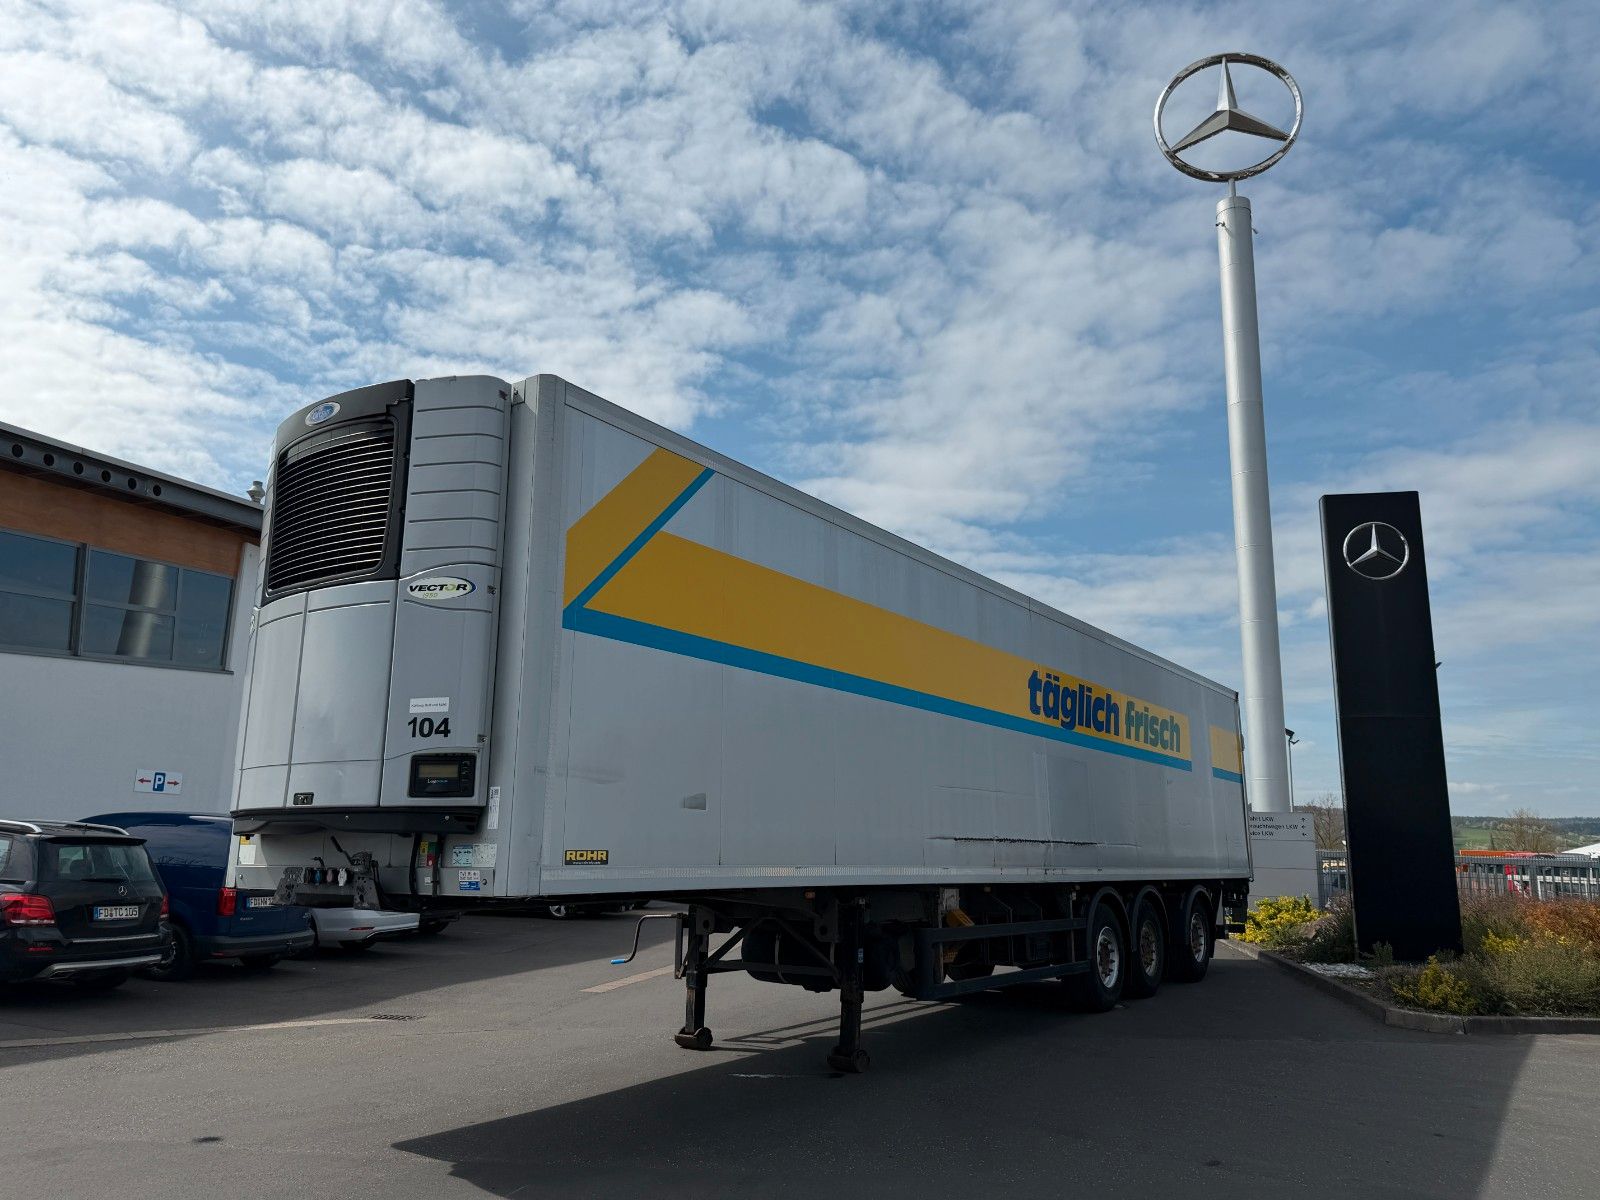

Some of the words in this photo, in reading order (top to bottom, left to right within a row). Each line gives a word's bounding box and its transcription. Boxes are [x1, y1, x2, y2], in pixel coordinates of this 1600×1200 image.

[409, 584, 468, 592] VECTOR
[1028, 670, 1120, 737] täglich
[1125, 700, 1181, 753] frisch
[408, 717, 451, 738] 104
[155, 774, 164, 789] P
[566, 850, 607, 861] ROHR
